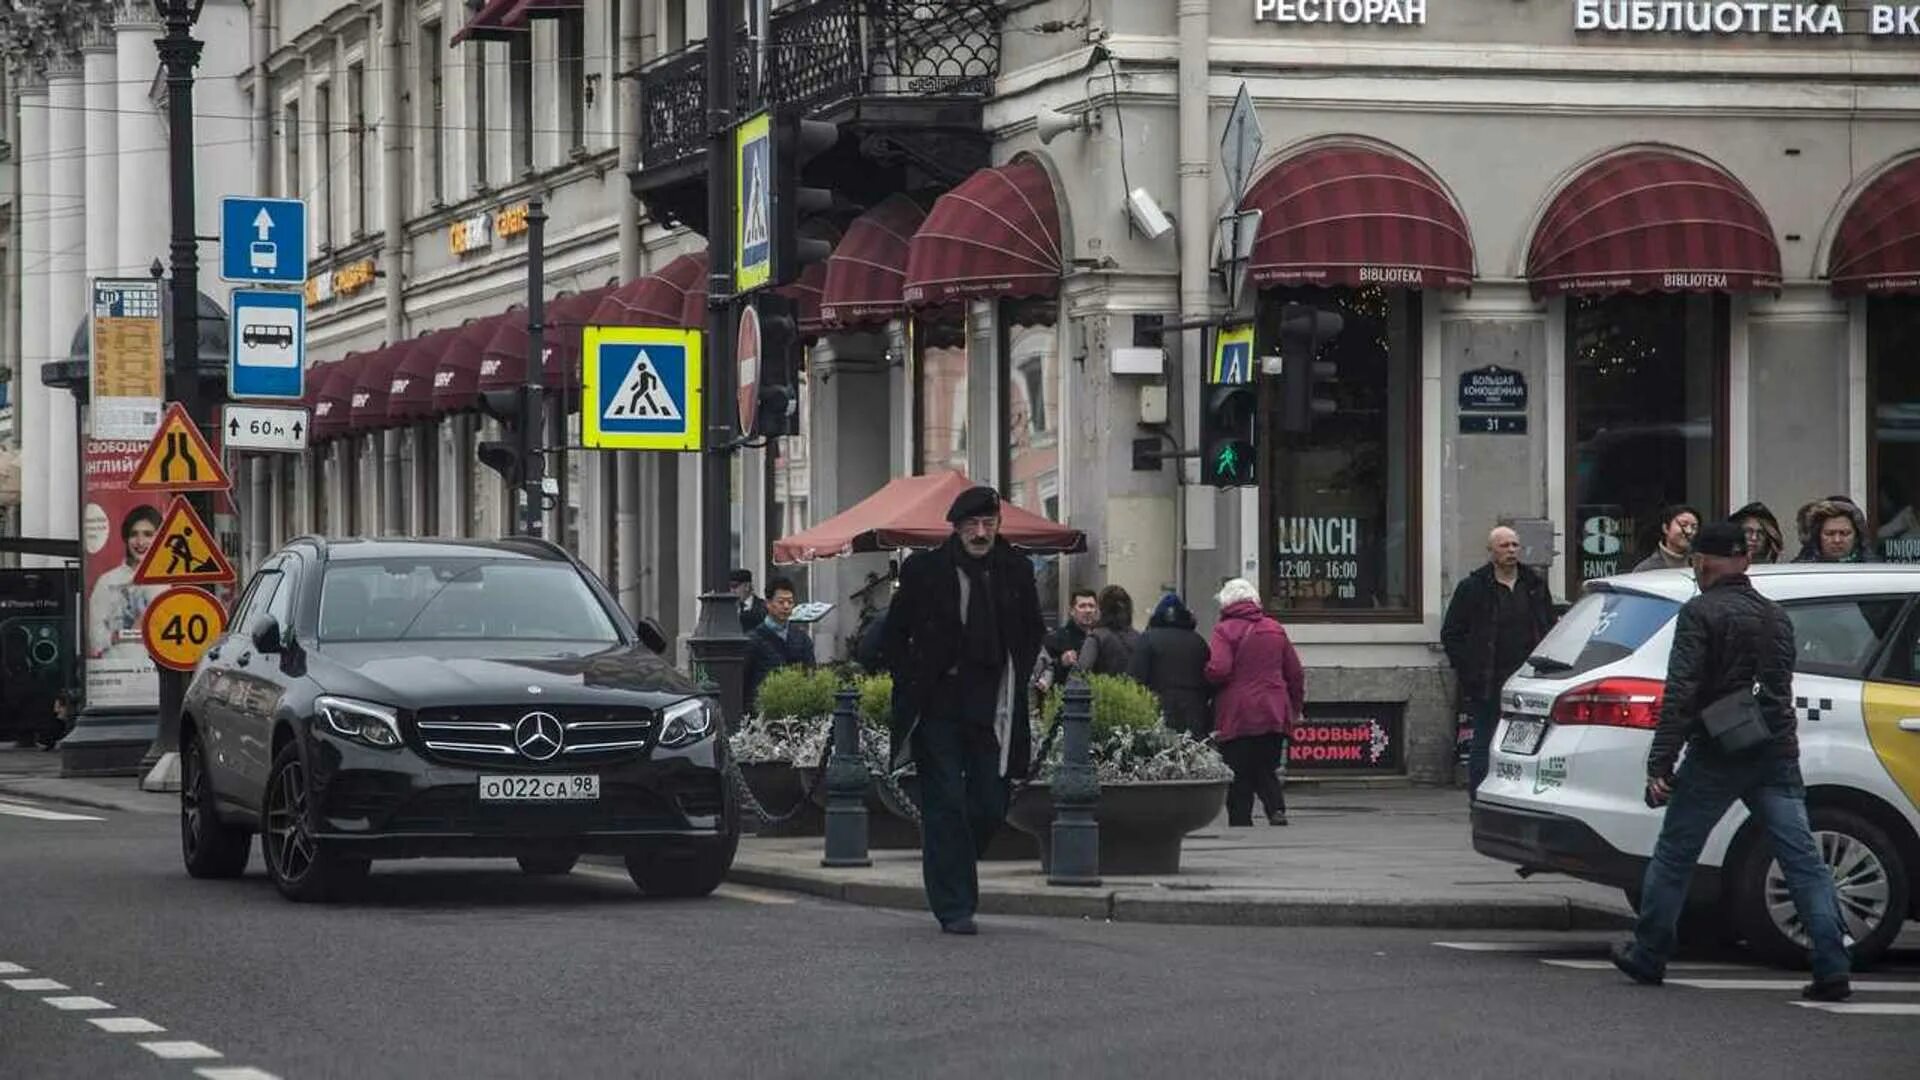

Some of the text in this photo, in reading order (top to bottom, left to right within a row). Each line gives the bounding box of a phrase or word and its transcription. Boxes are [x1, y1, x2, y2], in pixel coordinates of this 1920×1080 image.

[1256, 0, 1426, 23] РЕСТОРАН
[1359, 267, 1423, 282] BIBLIOTEKA
[1663, 272, 1728, 288] BIBLIOTEKA
[1487, 418, 1499, 431] 31
[1279, 517, 1357, 555] LUNCH
[1279, 560, 1311, 578] 12:00
[1326, 560, 1358, 579] 16:00
[1583, 560, 1617, 578] FANCY
[161, 614, 208, 646] 40
[1289, 745, 1362, 760] КРОЛИК
[574, 776, 593, 792] 98
